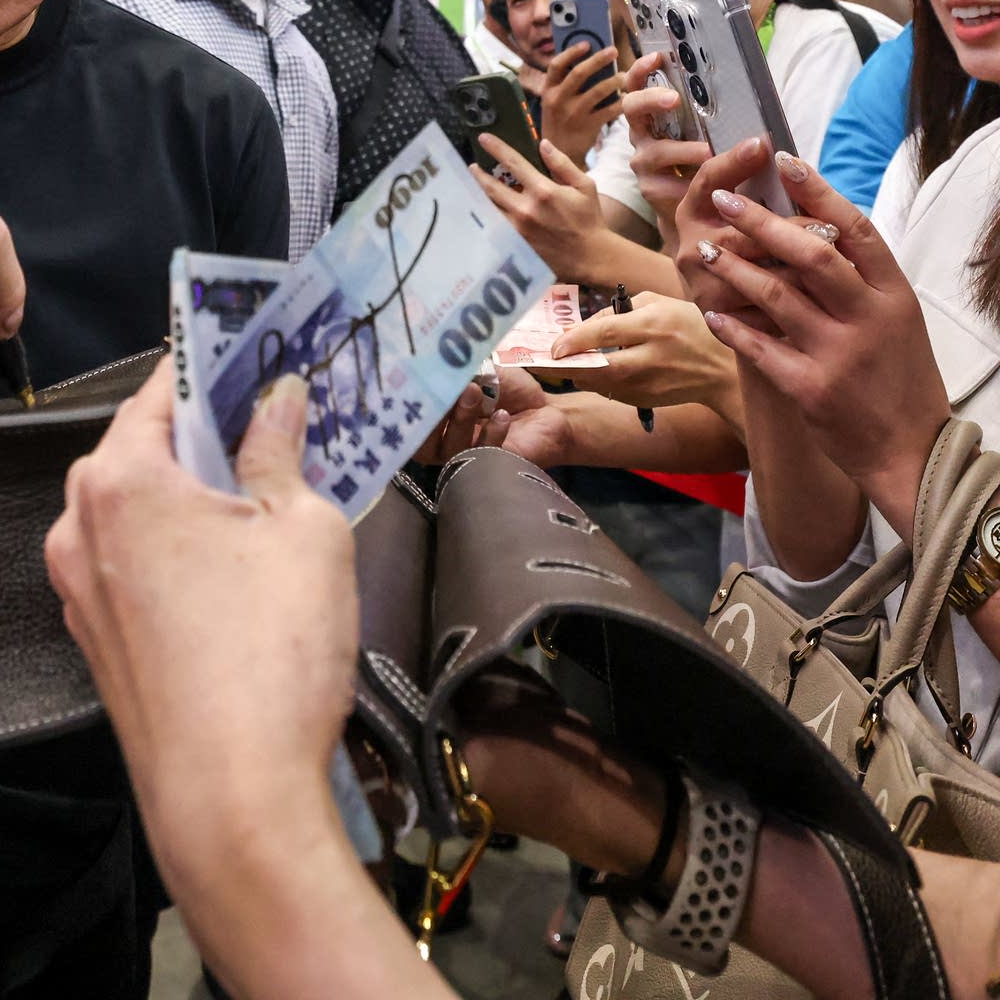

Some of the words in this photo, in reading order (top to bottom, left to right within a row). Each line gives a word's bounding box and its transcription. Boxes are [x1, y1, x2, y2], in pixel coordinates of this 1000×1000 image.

[375, 154, 439, 228] 1000
[438, 255, 534, 369] 1000
[552, 290, 576, 326] 100
[331, 400, 423, 504] 中華民國
